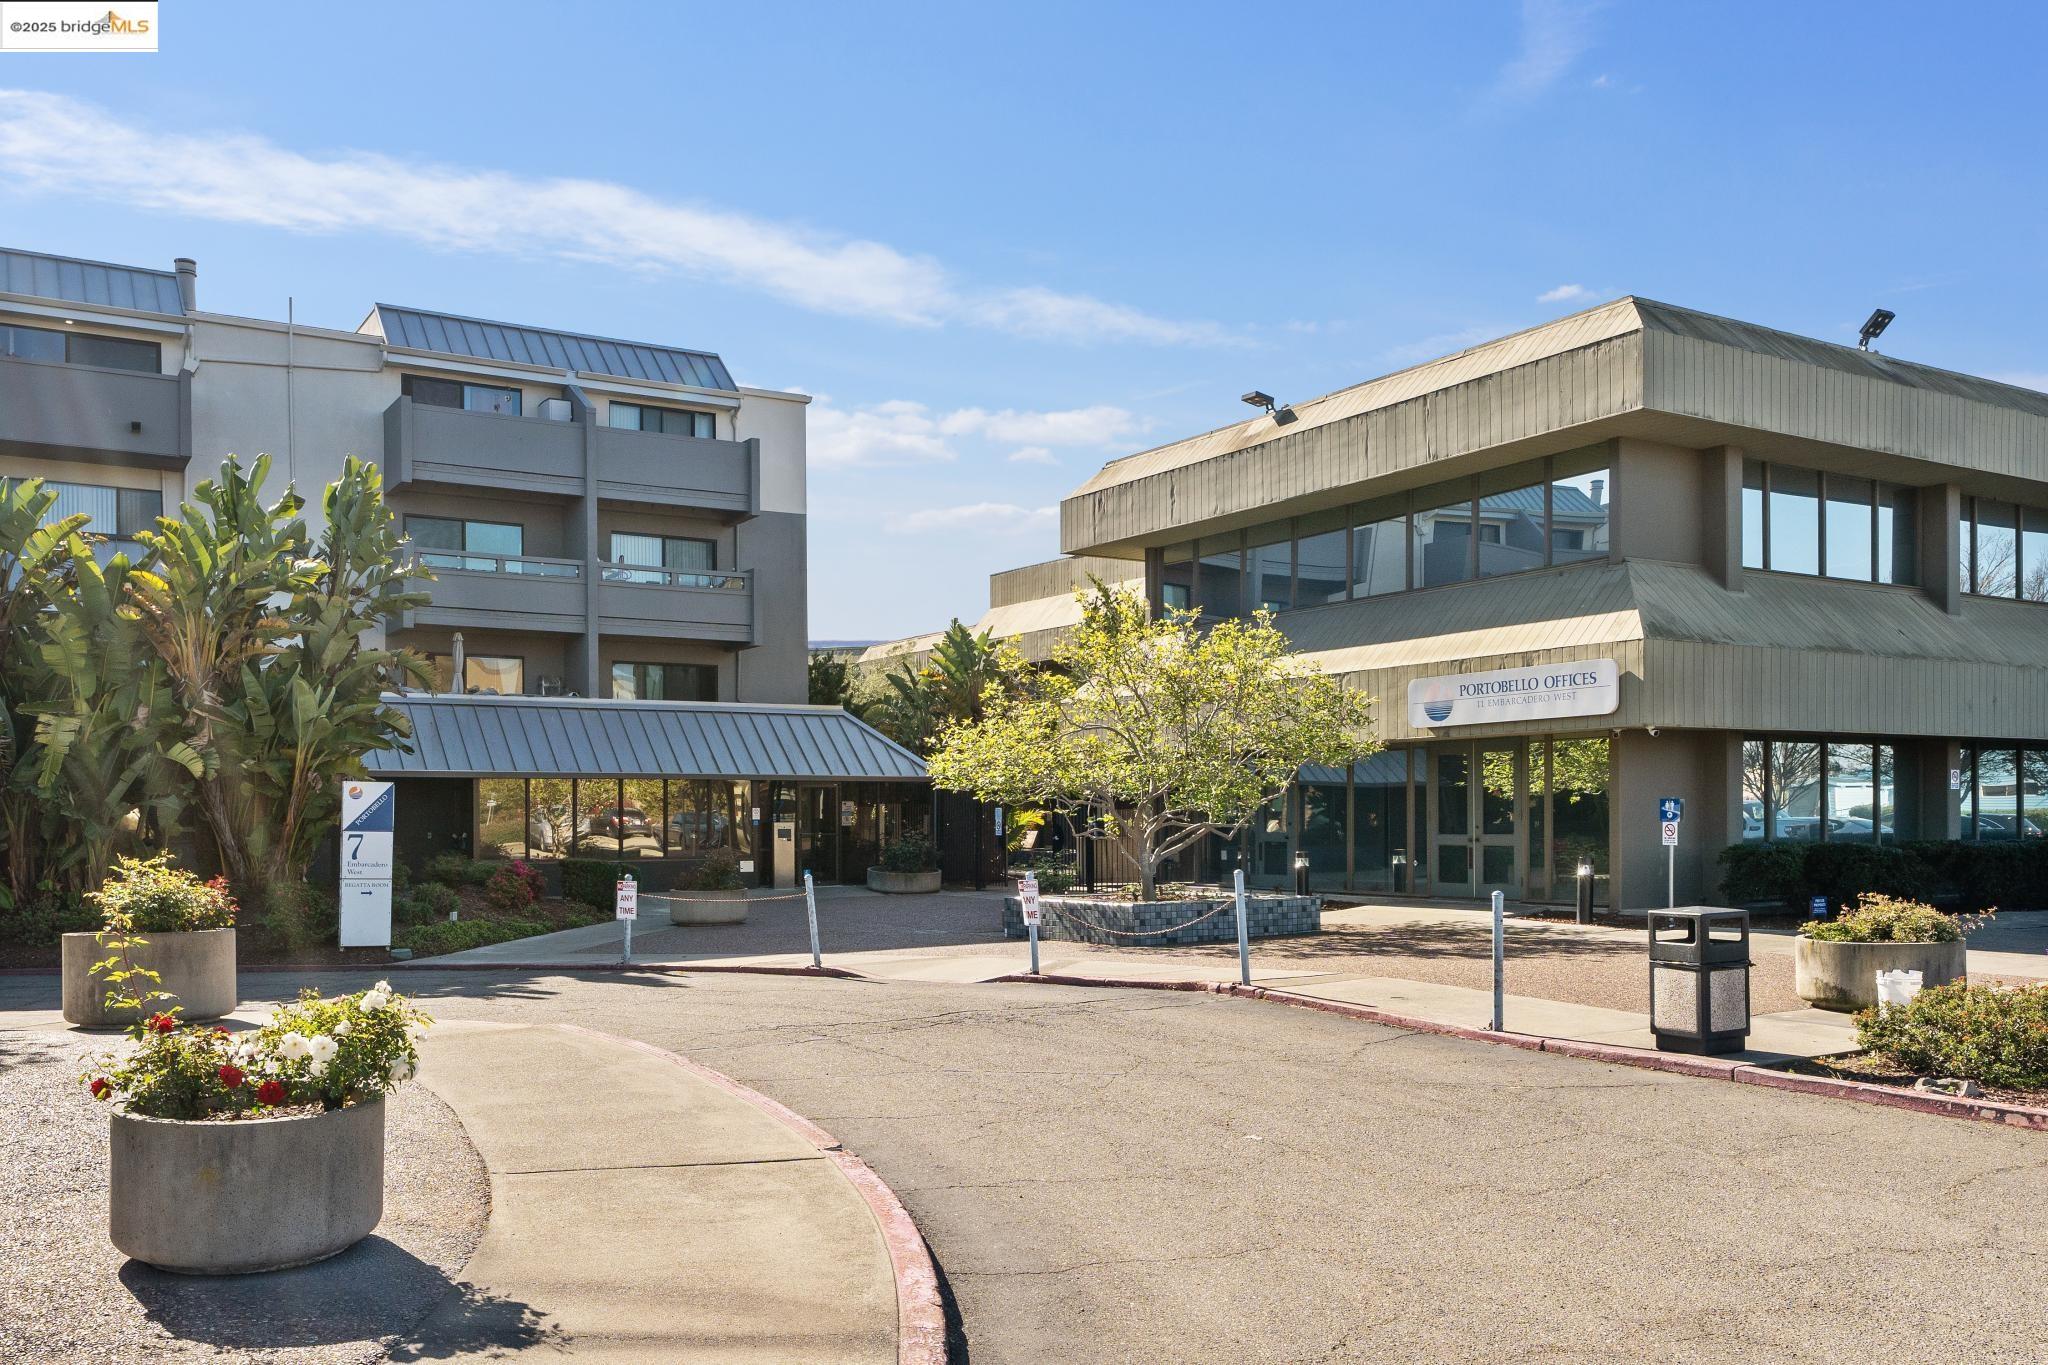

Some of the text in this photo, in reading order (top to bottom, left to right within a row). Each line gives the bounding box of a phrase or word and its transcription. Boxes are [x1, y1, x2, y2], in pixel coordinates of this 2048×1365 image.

[1460, 671, 1597, 697] PORTOBELLO OFFICES
[1487, 694, 1550, 707] EMBARCADERO
[1553, 691, 1577, 701] WEST
[355, 794, 388, 826] PORTOBELLO
[347, 833, 364, 860] 7
[620, 894, 633, 902] ANY
[619, 906, 635, 915] TIME
